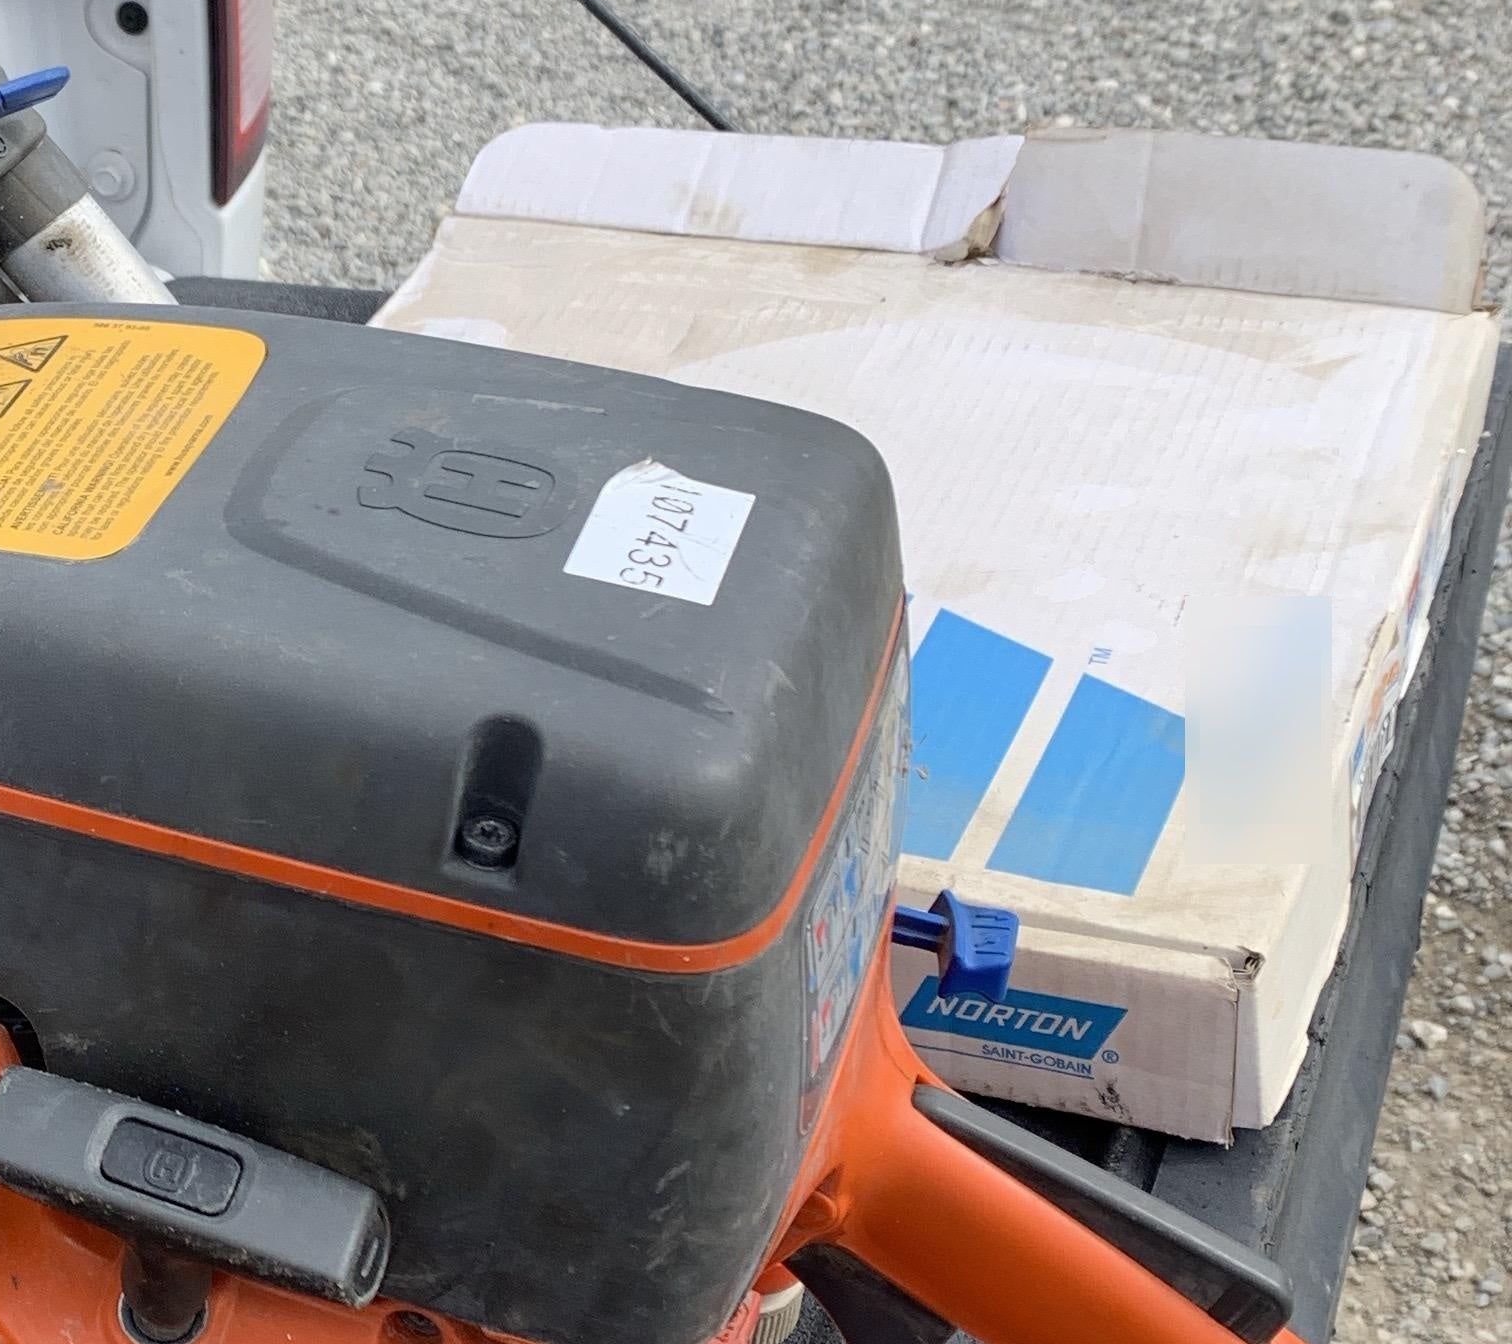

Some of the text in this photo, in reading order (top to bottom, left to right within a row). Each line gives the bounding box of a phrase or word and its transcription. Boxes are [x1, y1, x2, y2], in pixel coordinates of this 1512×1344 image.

[619, 483, 703, 588] 107435
[1088, 647, 1113, 665] TM
[926, 996, 1093, 1041] NORTON
[981, 1044, 1093, 1075] SAINT-GOBAIN
